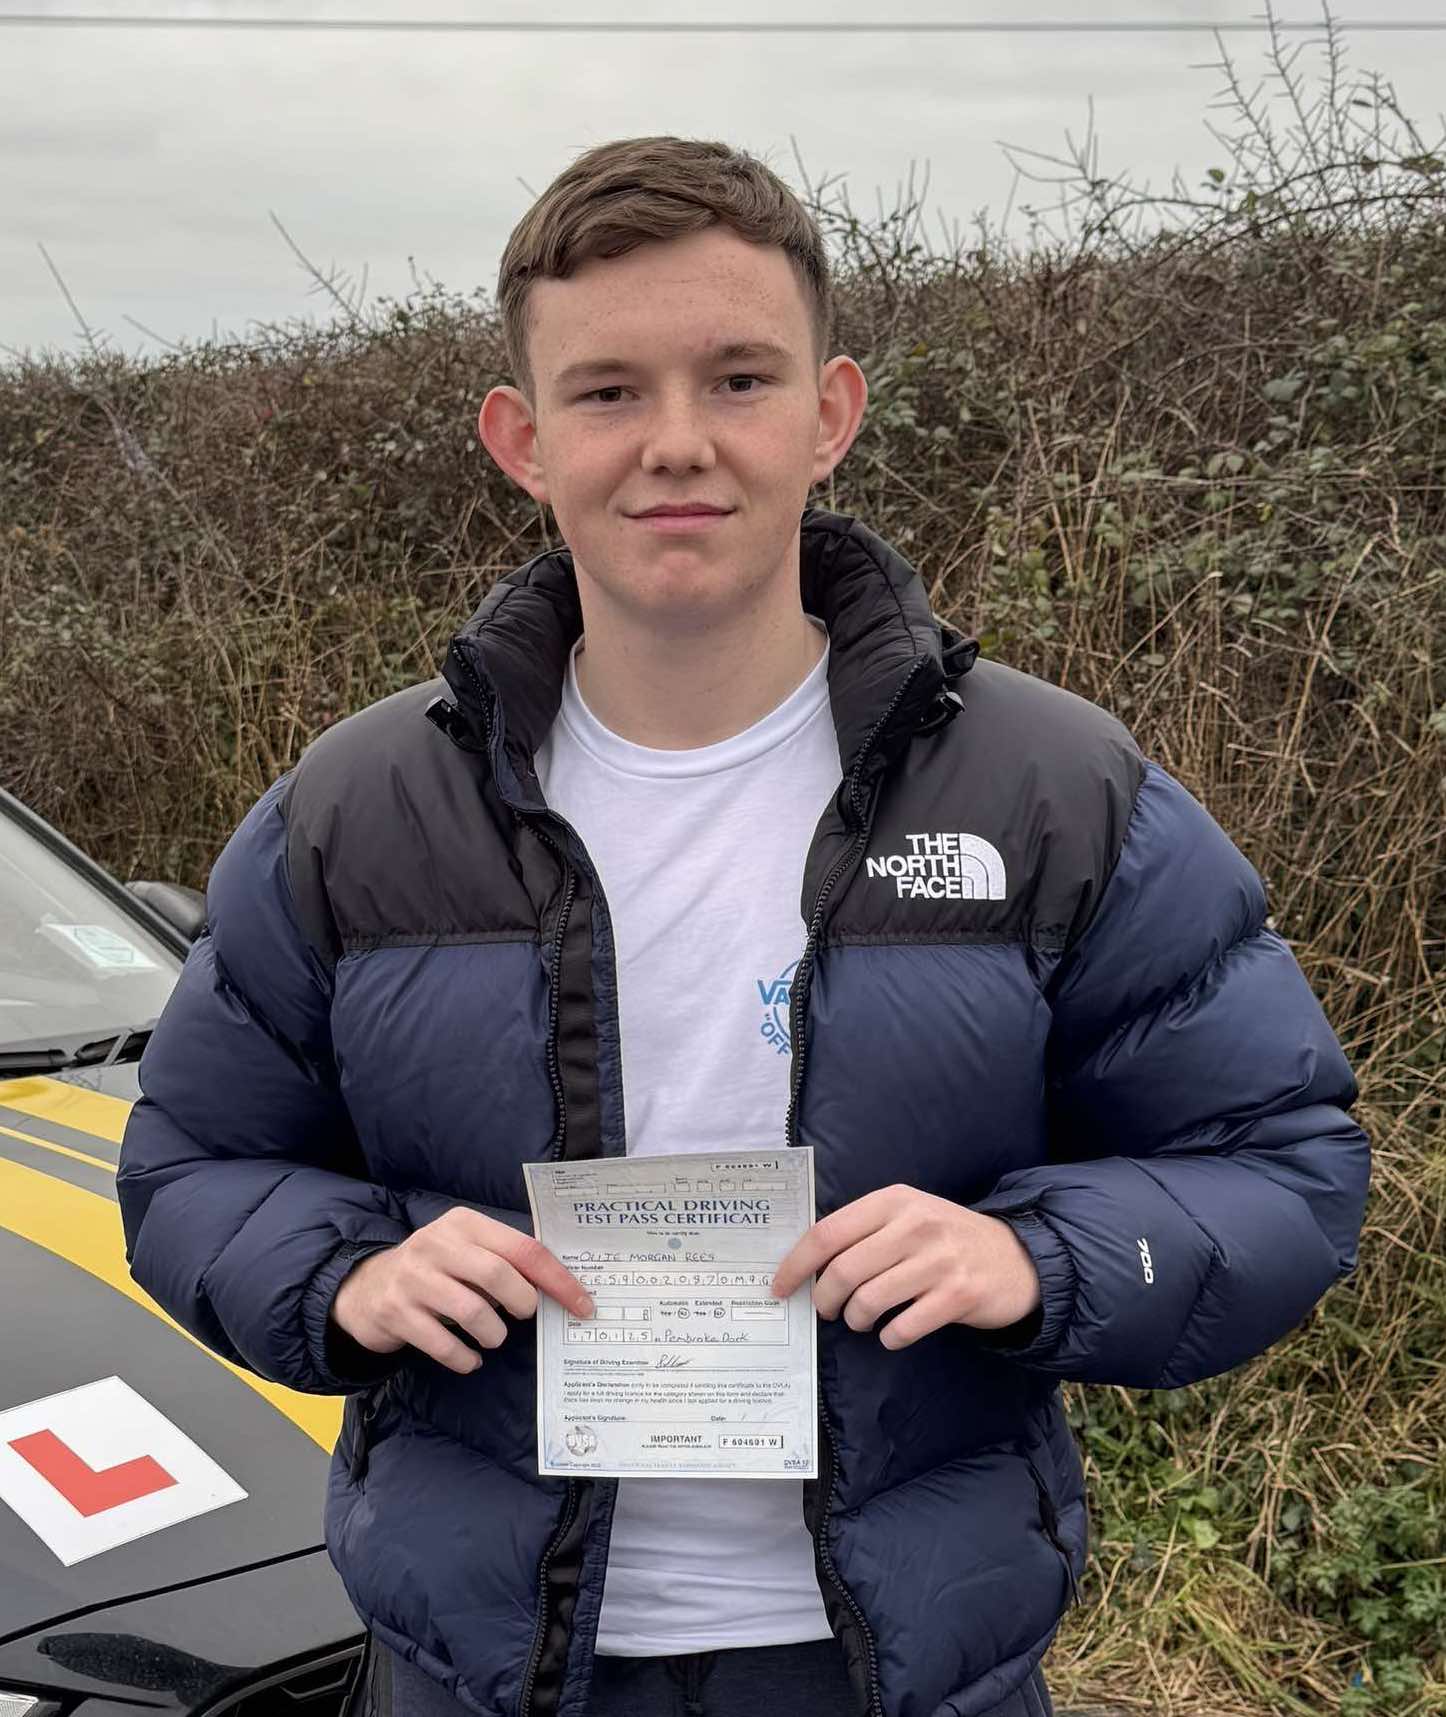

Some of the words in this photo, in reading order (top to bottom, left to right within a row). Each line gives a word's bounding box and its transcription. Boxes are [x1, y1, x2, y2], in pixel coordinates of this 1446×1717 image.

[905, 833, 959, 855] THE
[866, 855, 960, 878] NORTH
[896, 876, 962, 900] FACE
[757, 979, 792, 1006] VA
[573, 1200, 677, 1212] PRACTICAL
[683, 1199, 770, 1211] DRIVING
[575, 1213, 612, 1224] TEST
[619, 1213, 659, 1224] PASS
[663, 1212, 771, 1224] CERTIFICATE
[1136, 1237, 1154, 1284] 700
[663, 1328, 720, 1344] Pembroke
[650, 1434, 702, 1443] IMPORTANT
[768, 1438, 778, 1447] W
[7, 1428, 179, 1518] L
